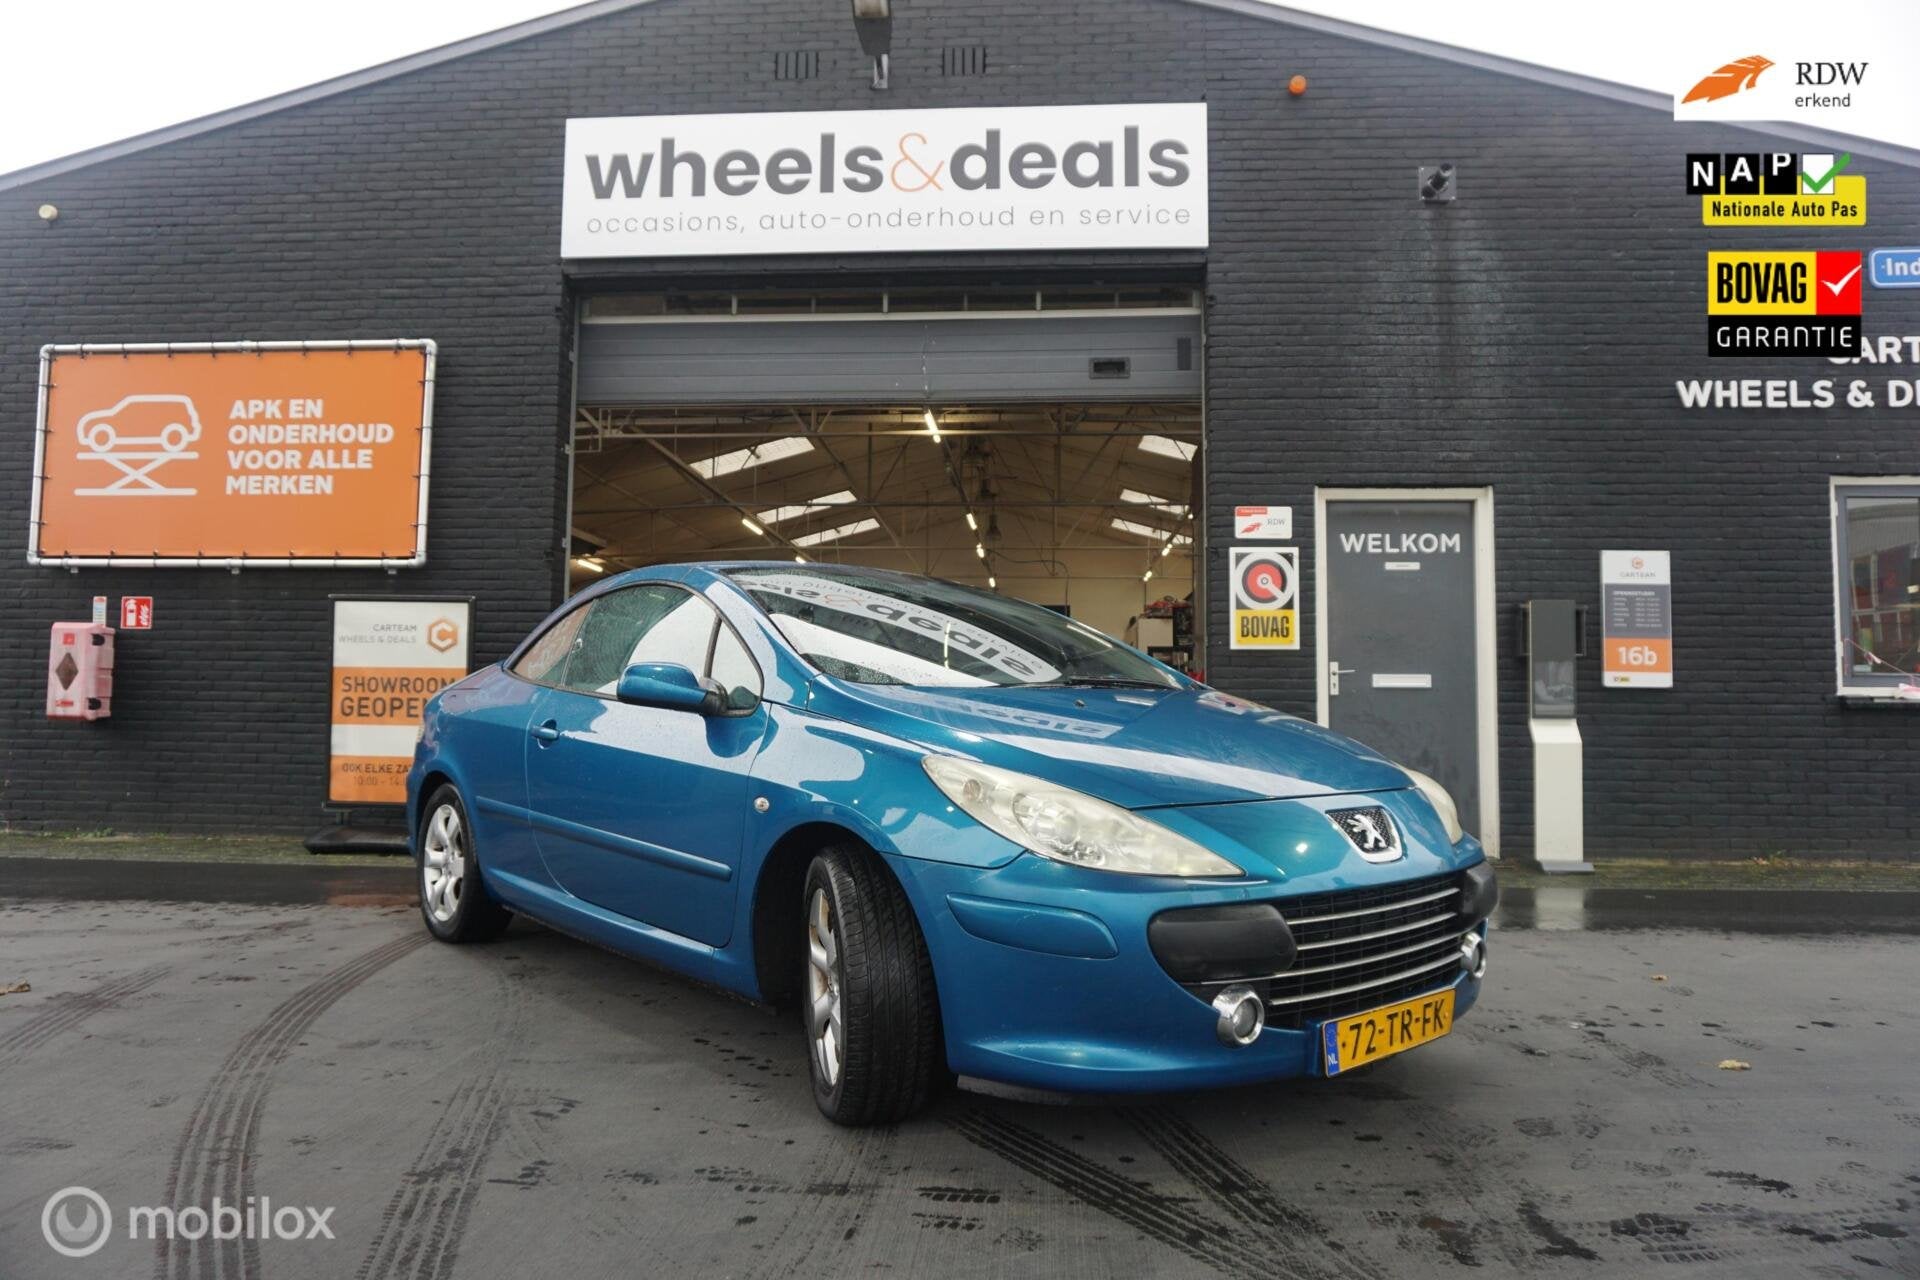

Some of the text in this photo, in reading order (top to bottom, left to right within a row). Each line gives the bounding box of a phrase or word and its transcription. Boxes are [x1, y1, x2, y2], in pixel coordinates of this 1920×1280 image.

[586, 204, 1191, 235] occasions, auto-onderhoud en service
[1676, 379, 1920, 409] WHEELS & D
[228, 398, 324, 420] APK EN
[227, 422, 395, 445] ONDERHOUD
[227, 448, 374, 470] VOOR ALLE
[225, 474, 334, 496] MERKEN
[1339, 532, 1461, 554] WELKOM
[1240, 616, 1290, 638] BOVAG
[1617, 645, 1658, 666] 16b
[342, 762, 362, 773] OOK
[364, 763, 393, 774] ELKE
[1349, 998, 1445, 1060] 72-TR-FK
[1327, 1053, 1338, 1066] NL
